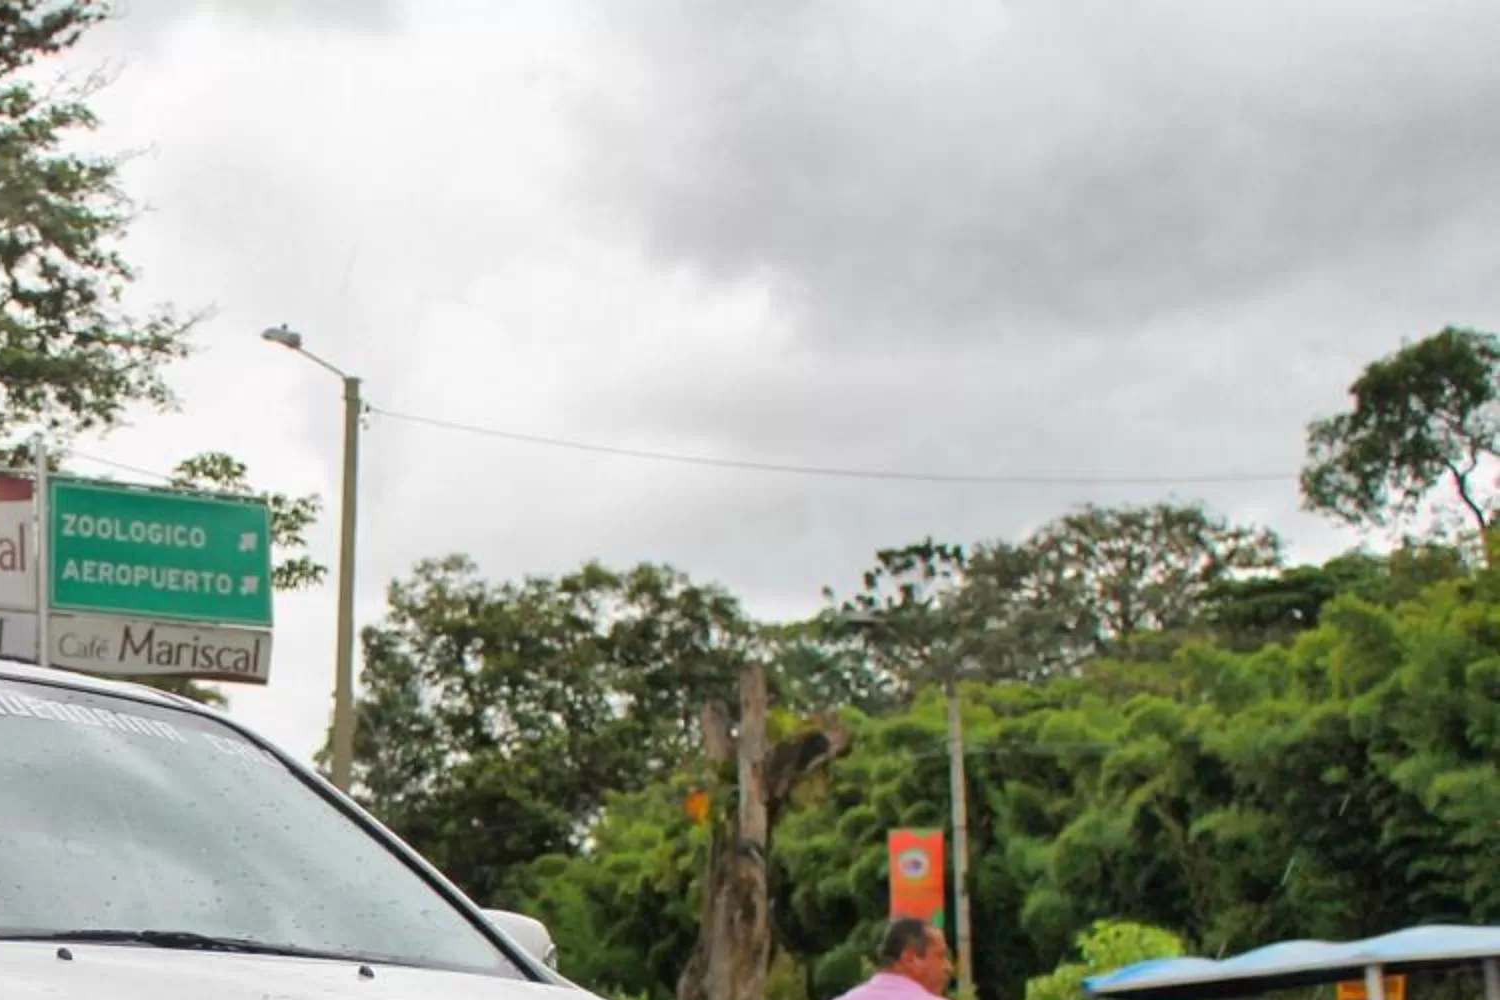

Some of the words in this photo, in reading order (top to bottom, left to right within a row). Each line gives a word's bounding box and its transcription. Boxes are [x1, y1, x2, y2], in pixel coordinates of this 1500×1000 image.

[61, 513, 207, 548] ZOOLOGICO
[62, 559, 232, 595] AEROPUERTO
[118, 625, 261, 674] Mariscal
